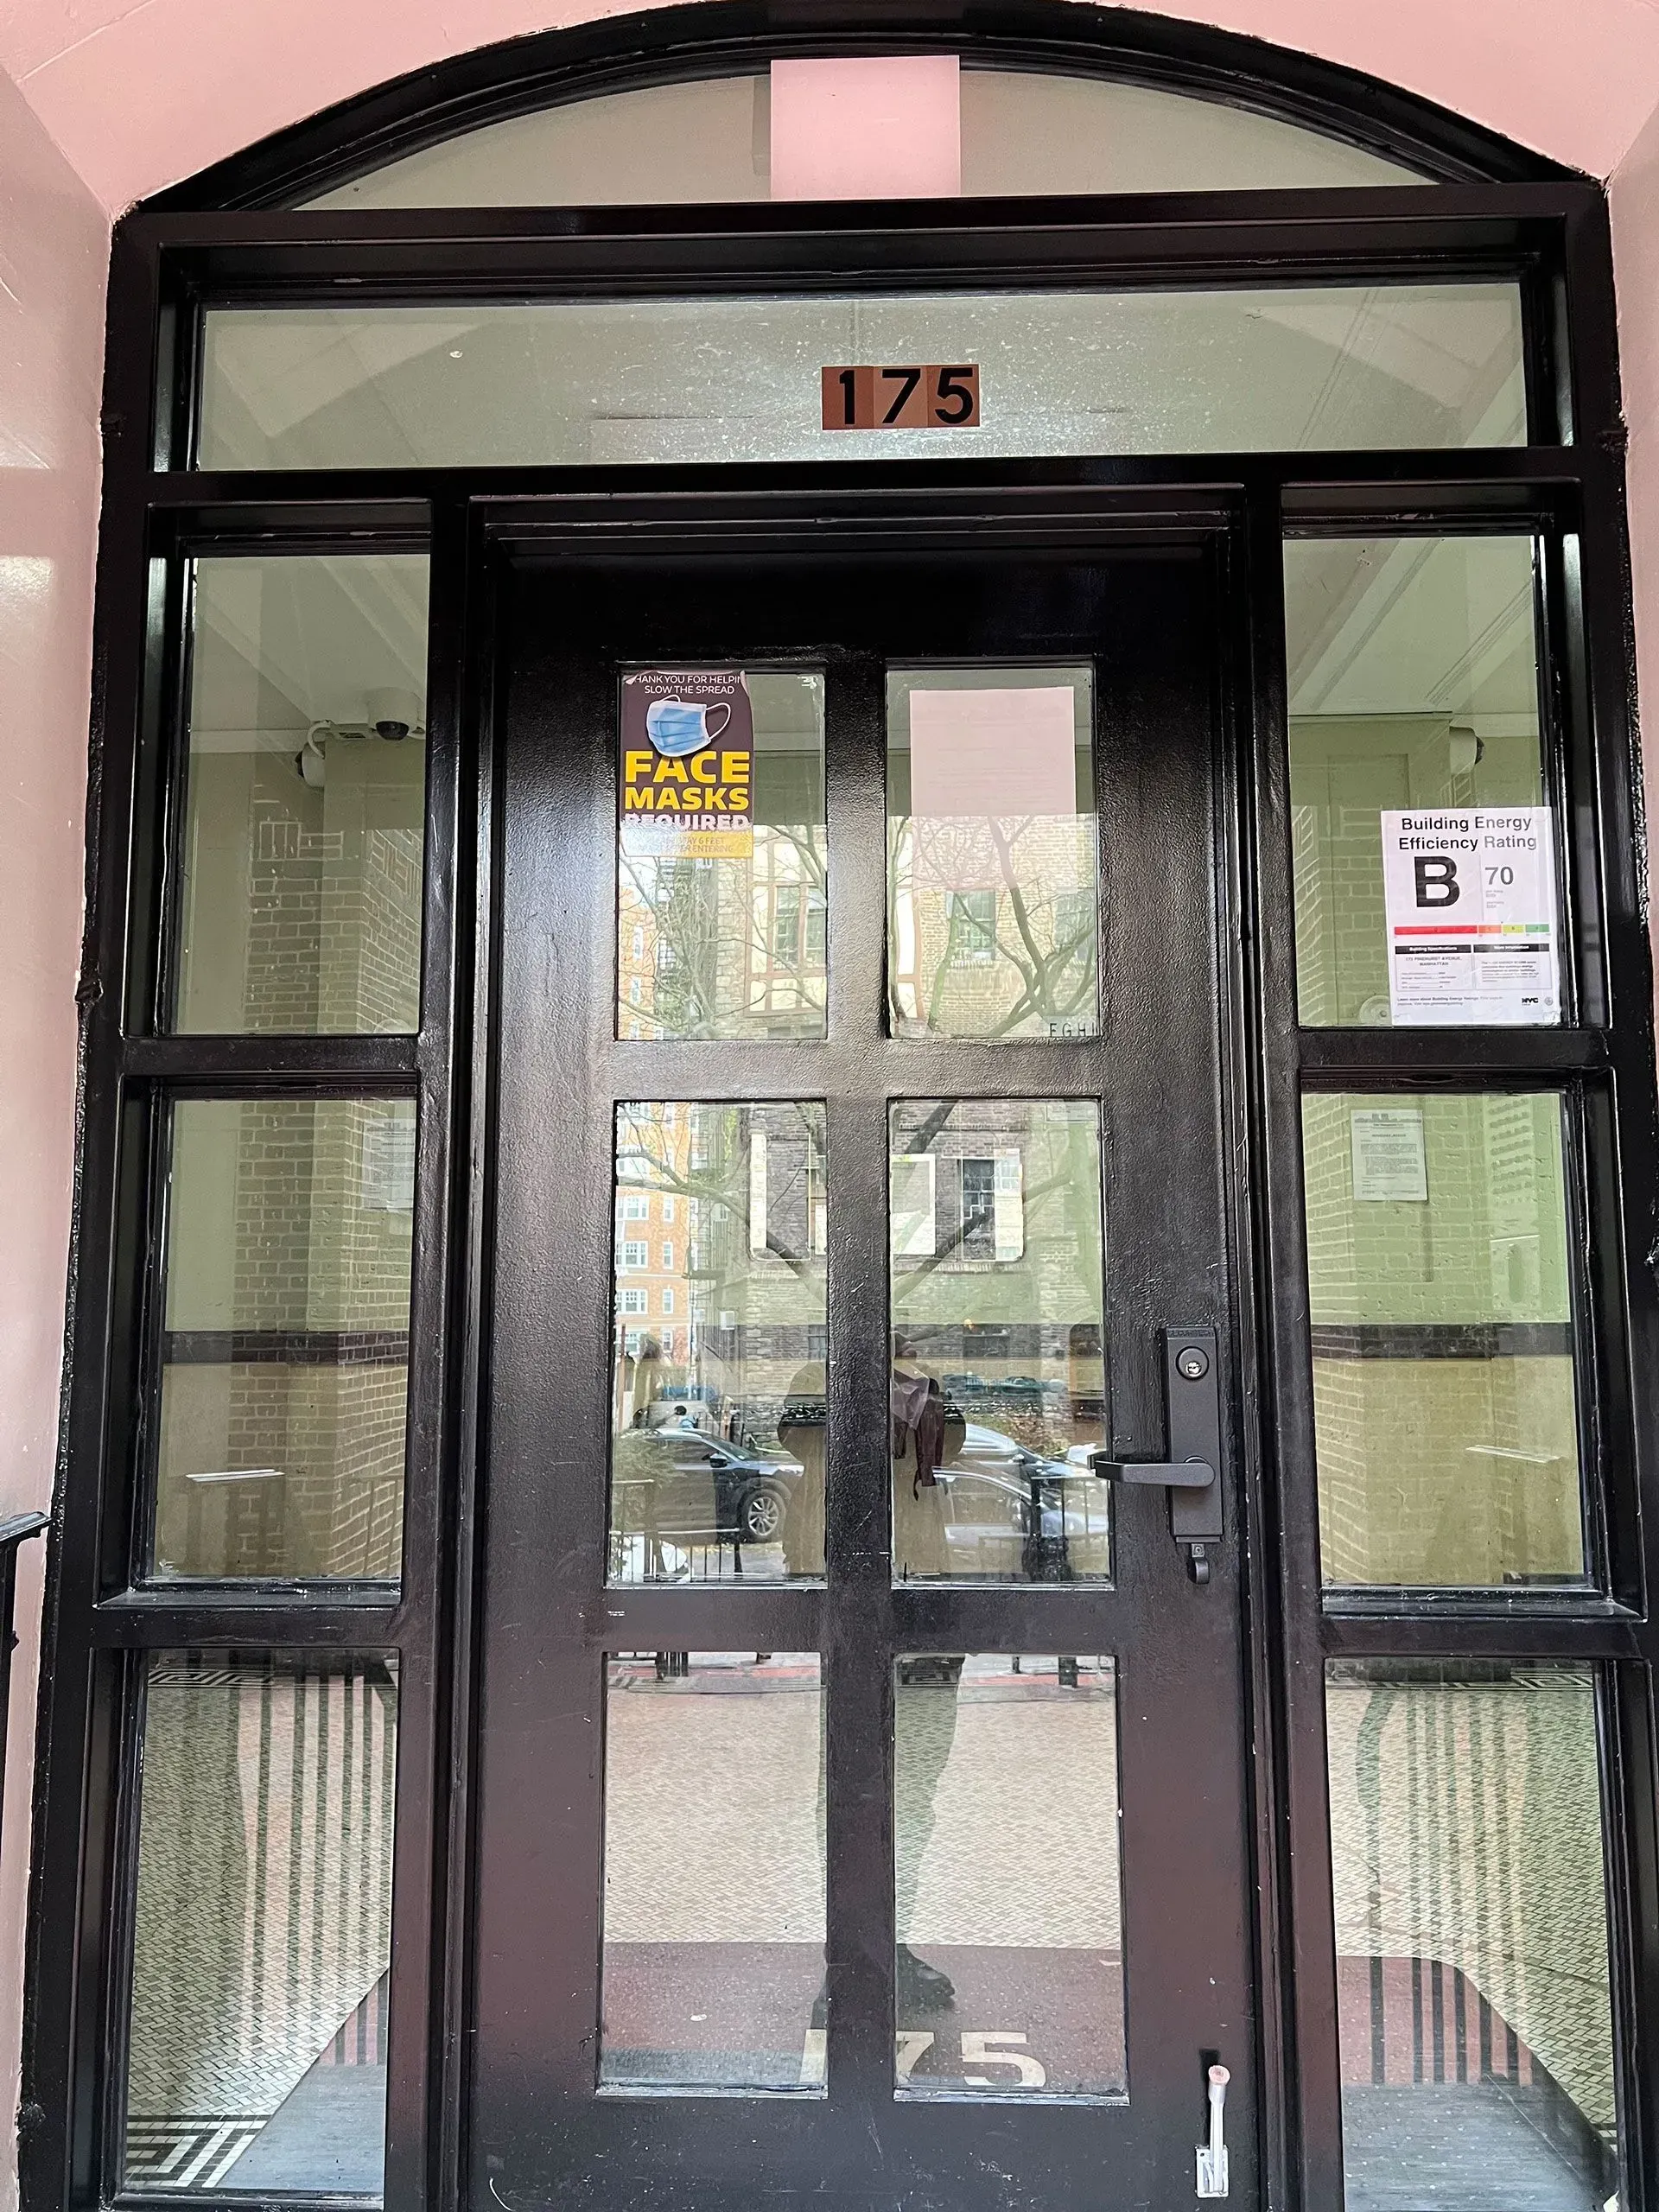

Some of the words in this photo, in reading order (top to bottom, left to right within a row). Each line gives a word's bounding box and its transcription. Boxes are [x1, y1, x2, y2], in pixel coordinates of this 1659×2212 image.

[839, 367, 973, 424] 175
[636, 675, 664, 683] HANK
[664, 675, 684, 683] YOU
[687, 675, 708, 683] FOR
[645, 685, 674, 694] SLOW
[674, 685, 694, 694] THE
[696, 685, 734, 695] SPREAD
[625, 750, 750, 784] FACE
[625, 786, 749, 811] MASKS
[623, 813, 751, 830] REQUIRED
[1402, 817, 1469, 831] Building
[1474, 816, 1532, 830] Energy
[1399, 836, 1478, 852] Efficiency
[1484, 836, 1537, 850] Rating
[1414, 855, 1460, 908] B
[1484, 866, 1514, 886] 70
